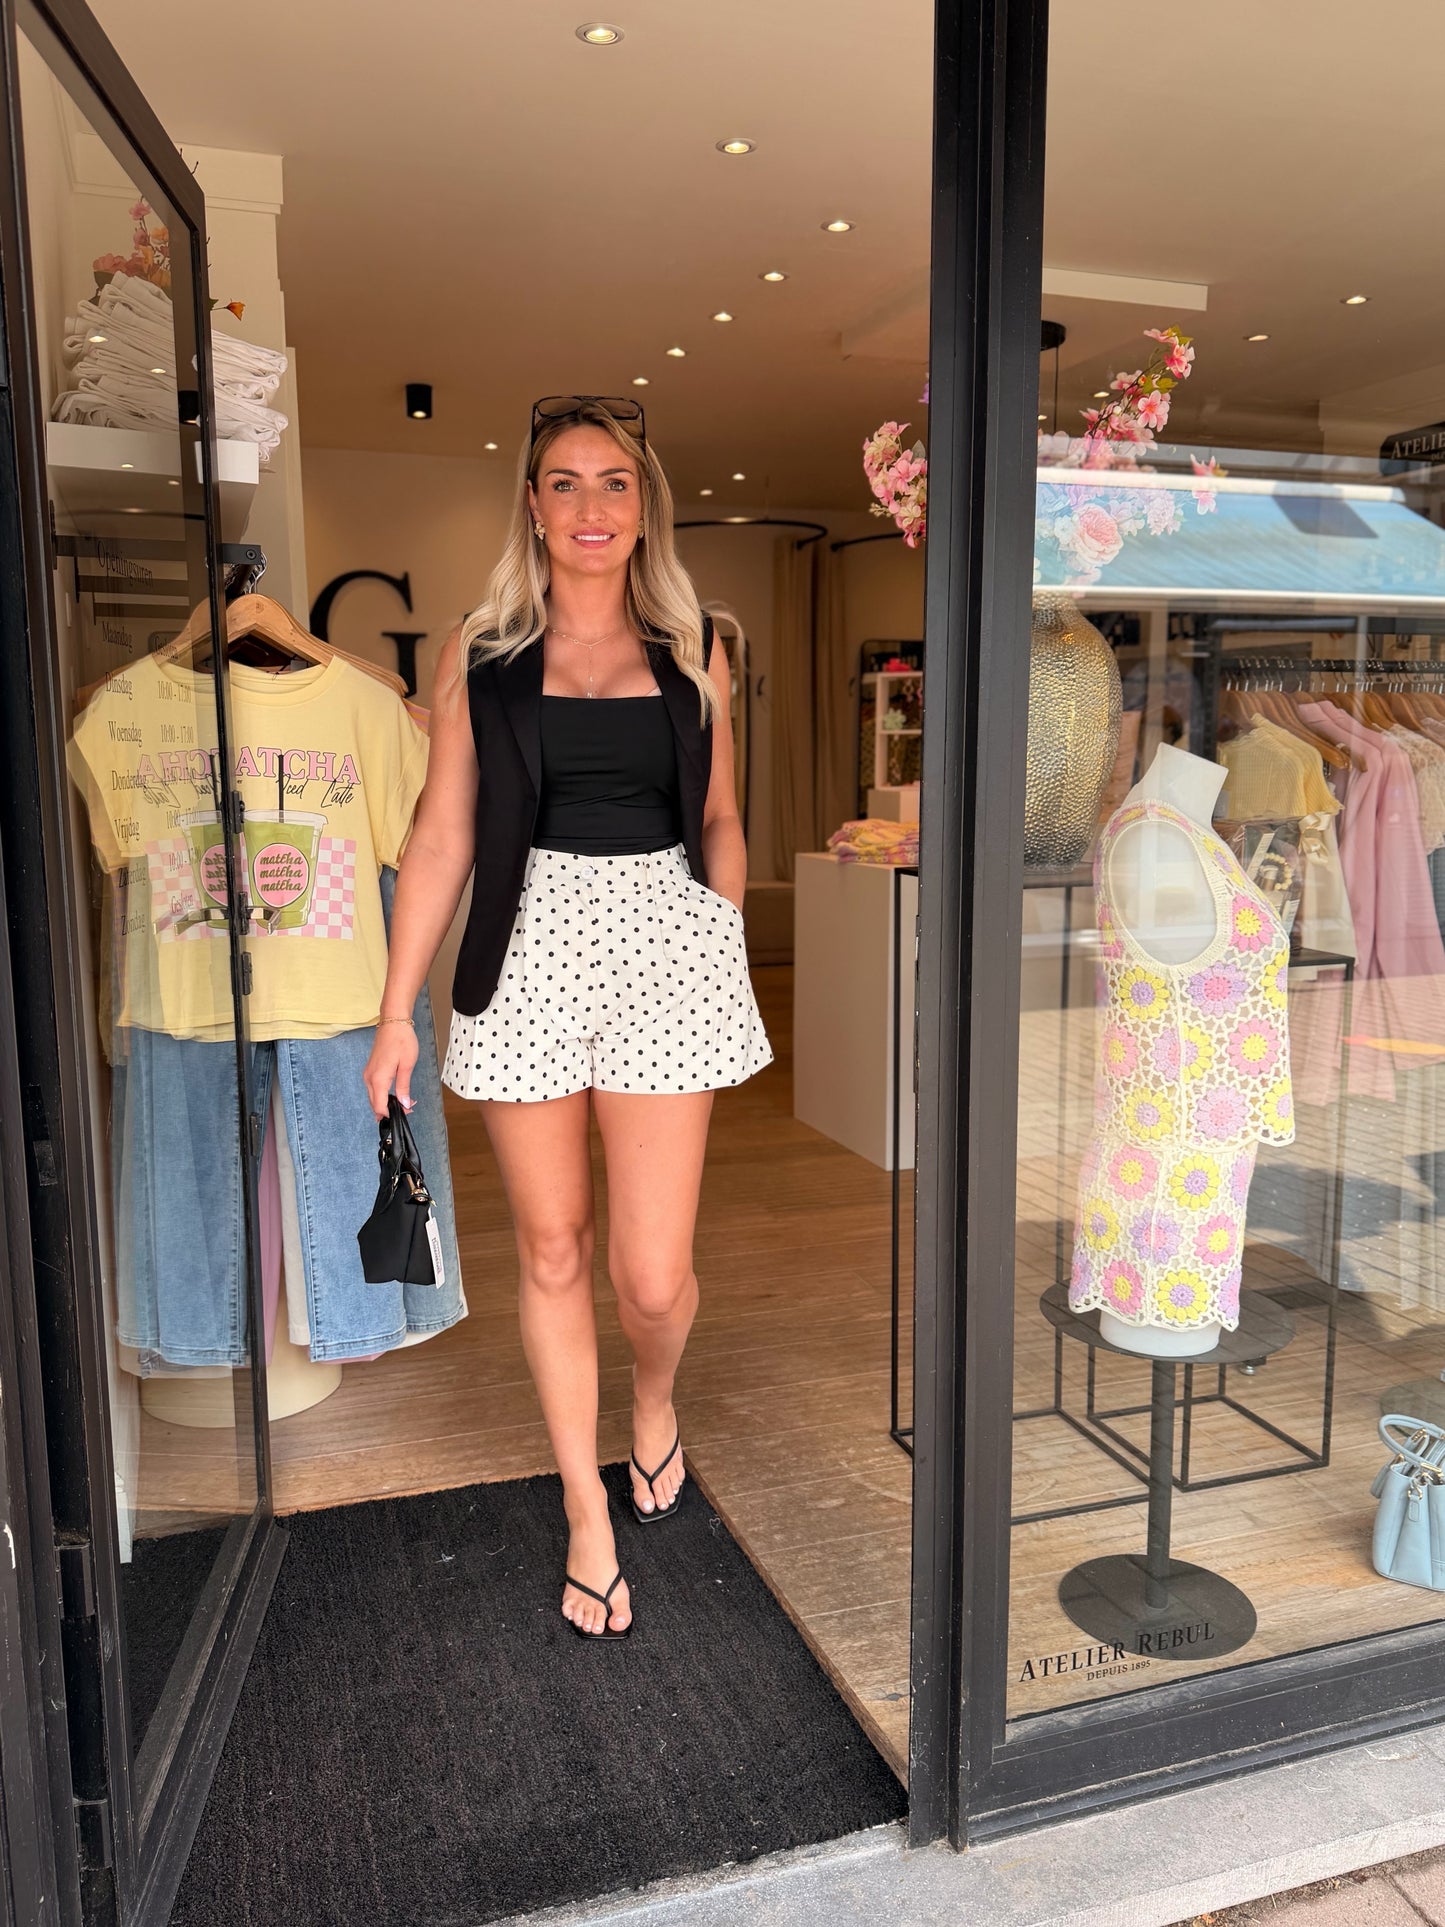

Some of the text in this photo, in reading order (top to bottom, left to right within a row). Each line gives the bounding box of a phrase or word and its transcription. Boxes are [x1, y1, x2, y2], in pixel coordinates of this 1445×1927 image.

[98, 541, 153, 588] Openingsuren
[102, 621, 133, 654] Maandag
[309, 570, 428, 698] G
[105, 671, 133, 701] Dinsdag
[108, 720, 142, 748] Woensdag
[320, 779, 354, 808] Latte
[114, 817, 140, 844] Vrijdag
[259, 851, 303, 866] matcha
[259, 865, 303, 879] matcha
[260, 879, 303, 893] matcha
[121, 910, 146, 936] Zondag
[1019, 1622, 1215, 1683] ATELIER REBUL
[1086, 1659, 1151, 1681] DEPUIS 1895
